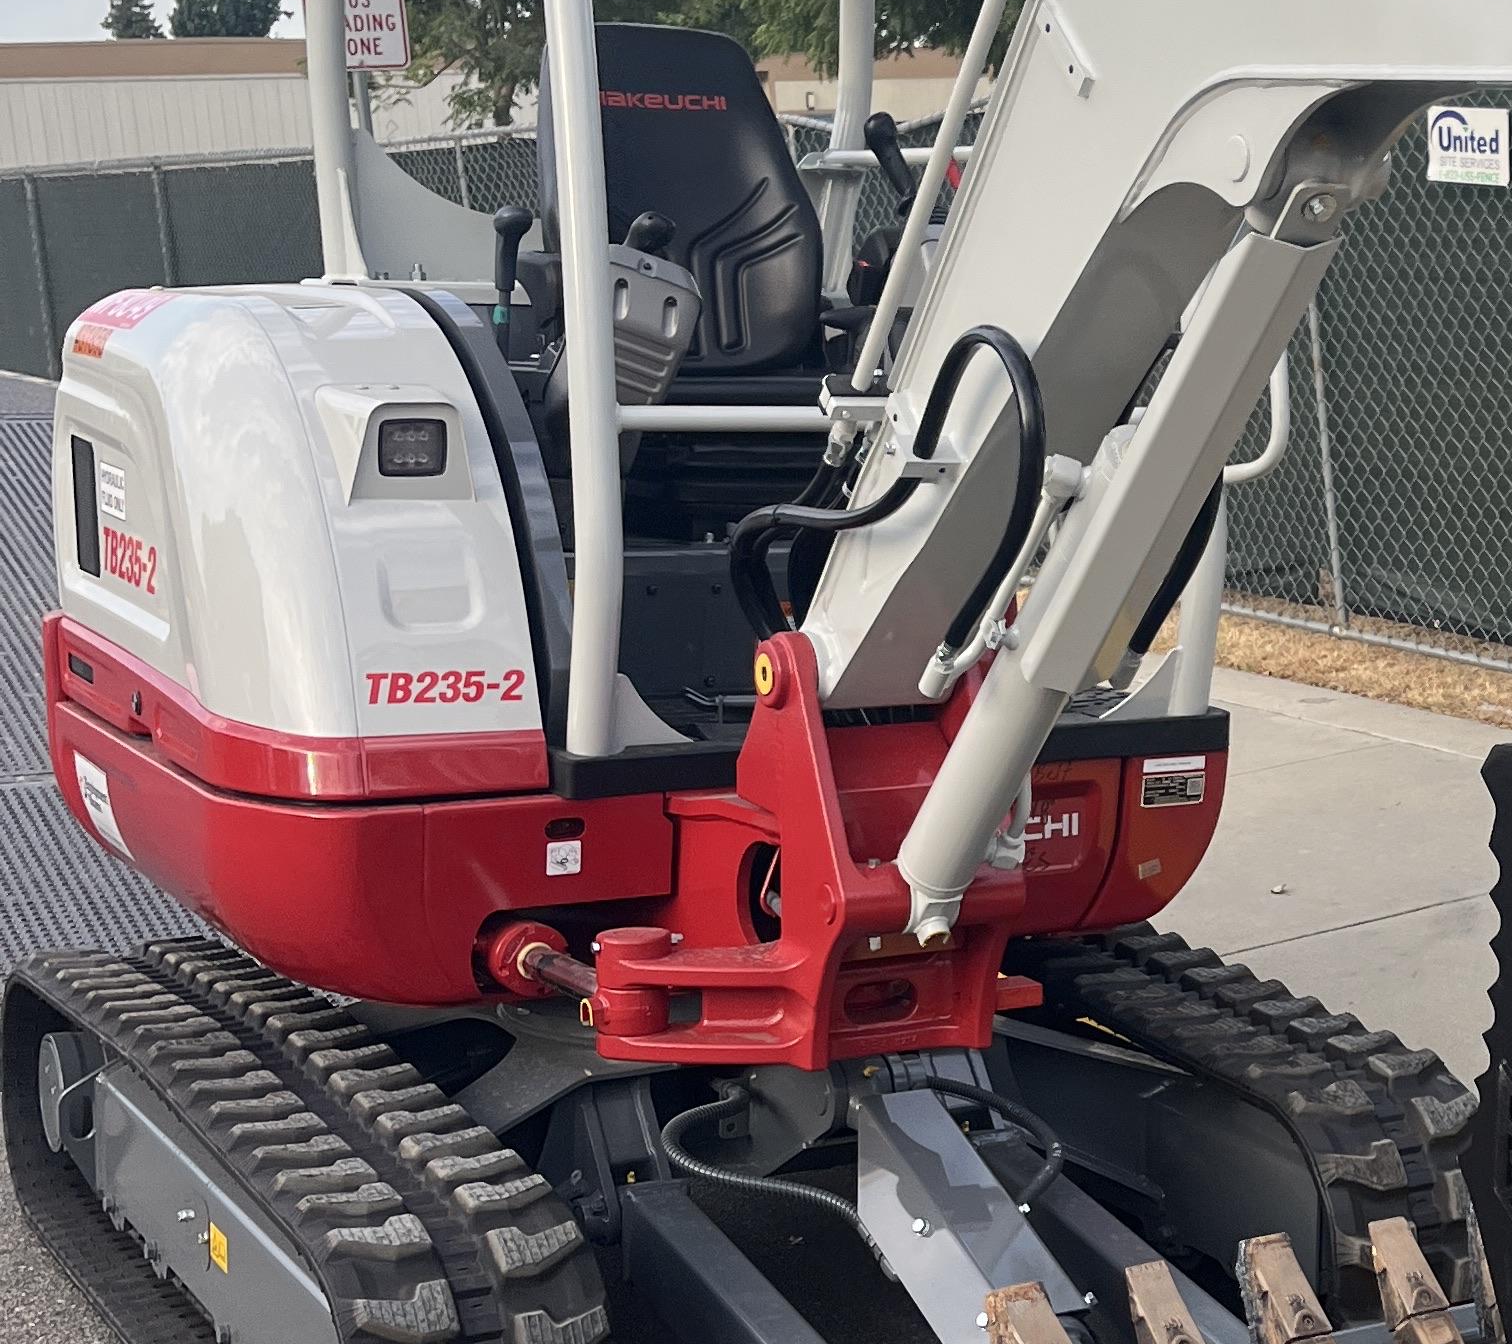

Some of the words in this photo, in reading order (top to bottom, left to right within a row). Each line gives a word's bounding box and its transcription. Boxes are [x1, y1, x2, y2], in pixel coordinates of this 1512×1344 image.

[344, 13, 397, 32] ADING
[347, 37, 384, 56] ONE
[1438, 125, 1500, 155] United
[103, 525, 157, 595] TB235-2
[366, 669, 525, 705] TB235-2
